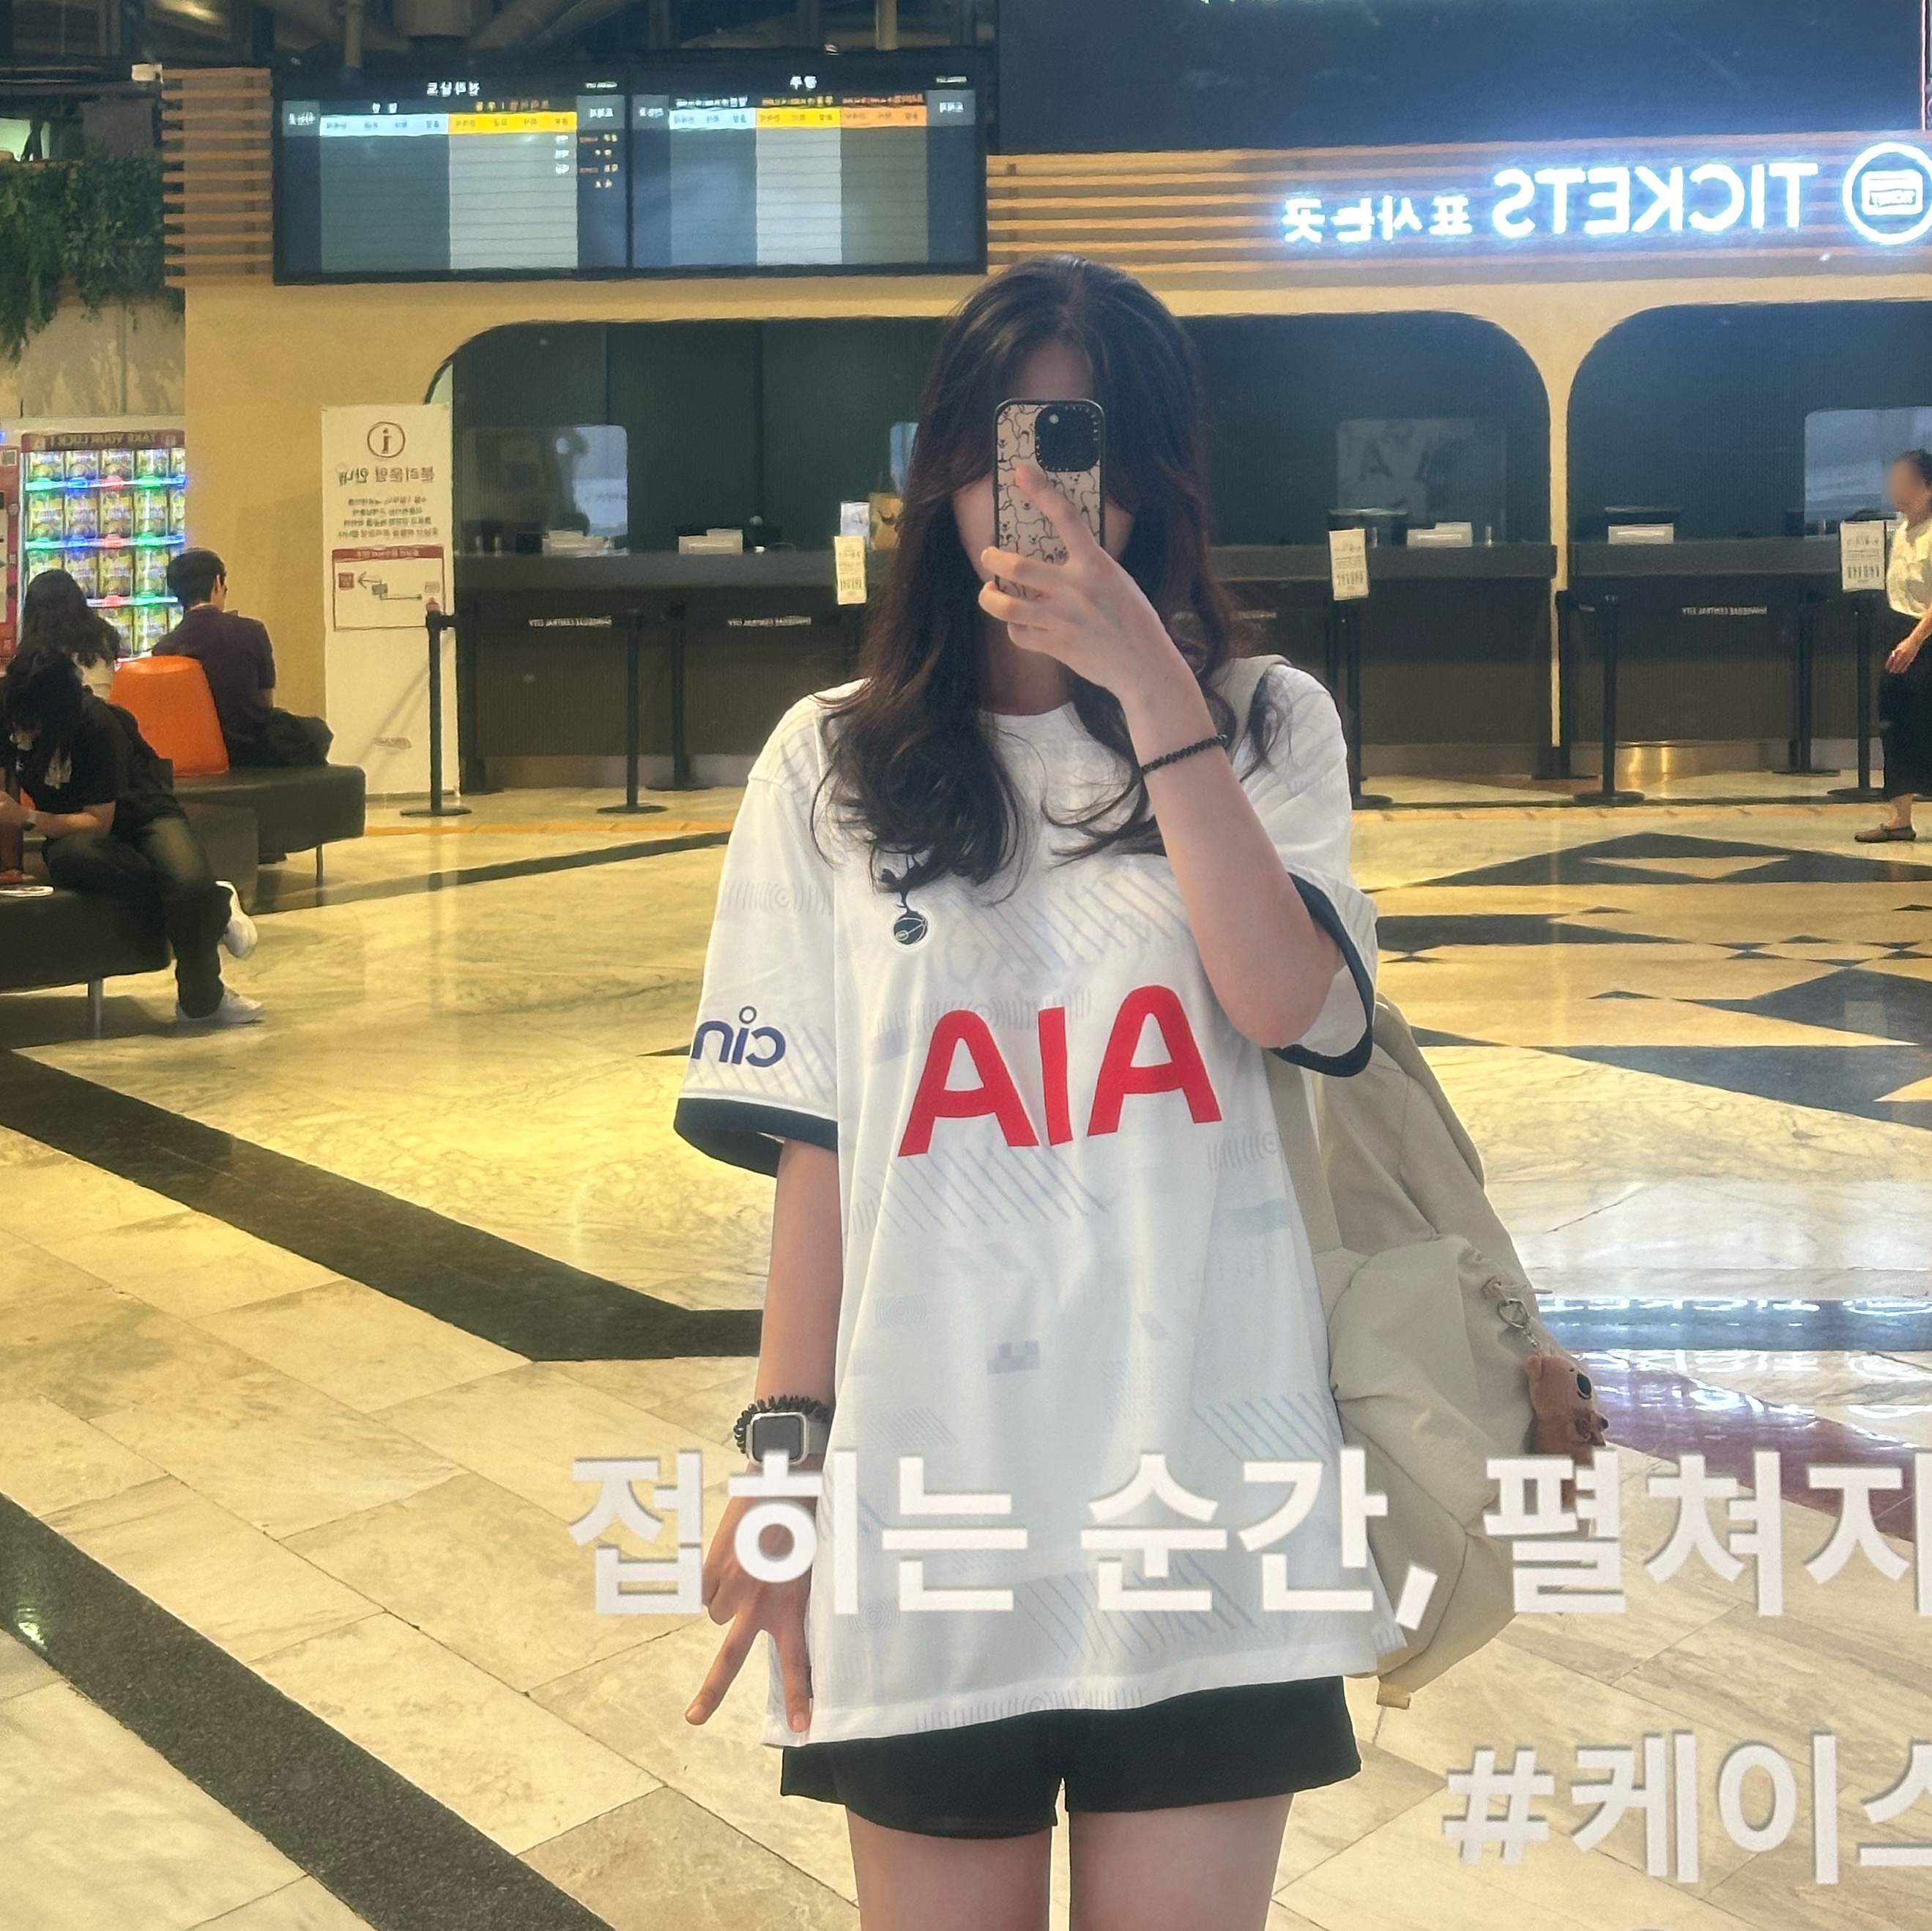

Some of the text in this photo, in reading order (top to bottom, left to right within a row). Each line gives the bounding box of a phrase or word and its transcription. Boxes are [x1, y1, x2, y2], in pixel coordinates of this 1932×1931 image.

[568, 1446, 1932, 1631] 접히는 순간, 펼쳐지
